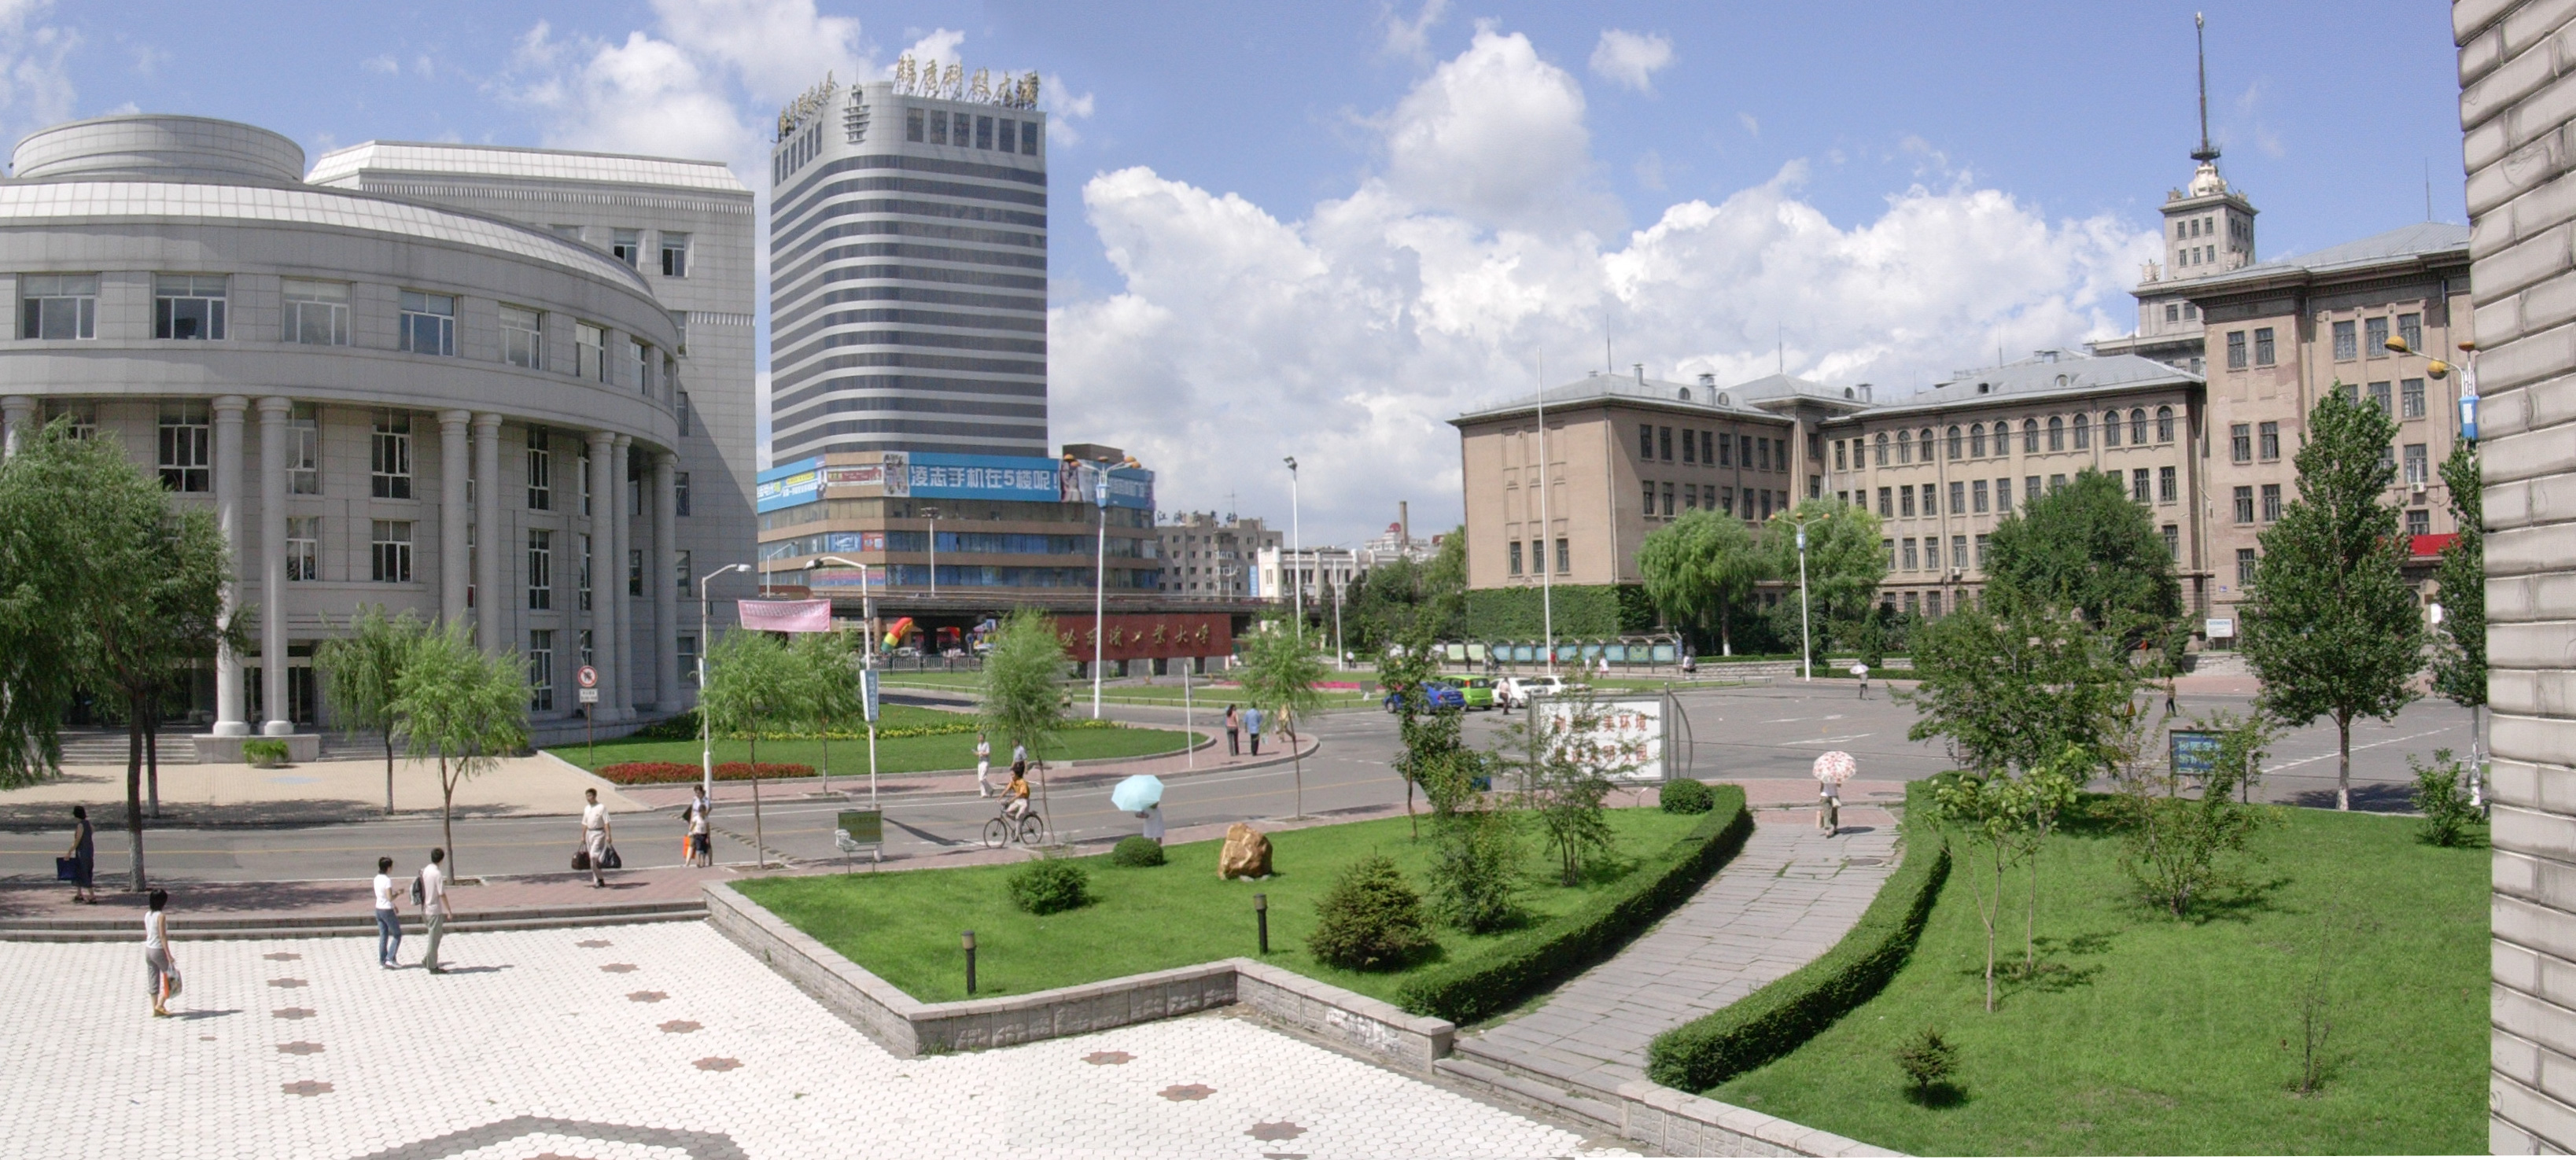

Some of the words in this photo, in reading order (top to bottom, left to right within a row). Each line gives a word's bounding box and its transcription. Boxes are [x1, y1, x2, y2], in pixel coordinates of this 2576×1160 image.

[910, 464, 1058, 492] 凌志手机在5楼呢!
[1060, 622, 1210, 648] 哈尔滨工业大学
